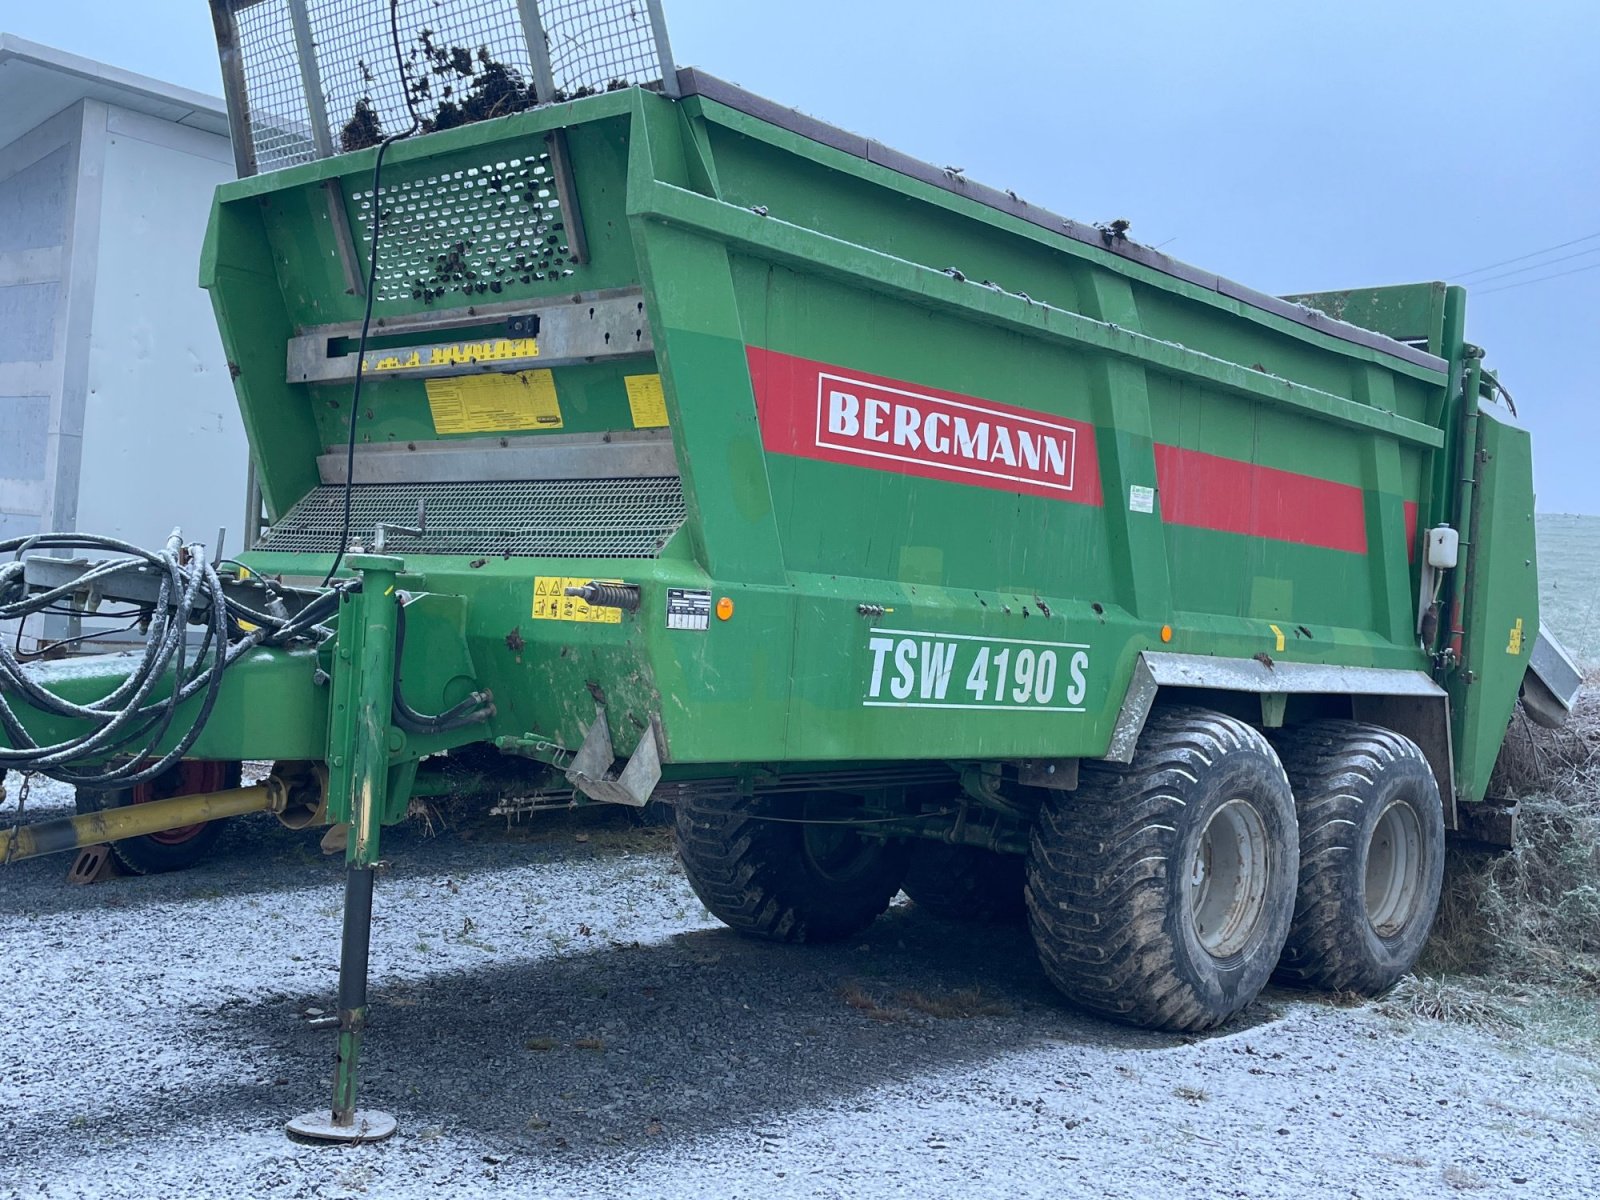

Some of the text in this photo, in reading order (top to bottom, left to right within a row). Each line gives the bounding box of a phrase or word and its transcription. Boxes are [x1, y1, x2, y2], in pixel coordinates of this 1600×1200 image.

[828, 390, 1067, 477] BERGMANN
[868, 637, 1089, 705] TSW 4190 S
